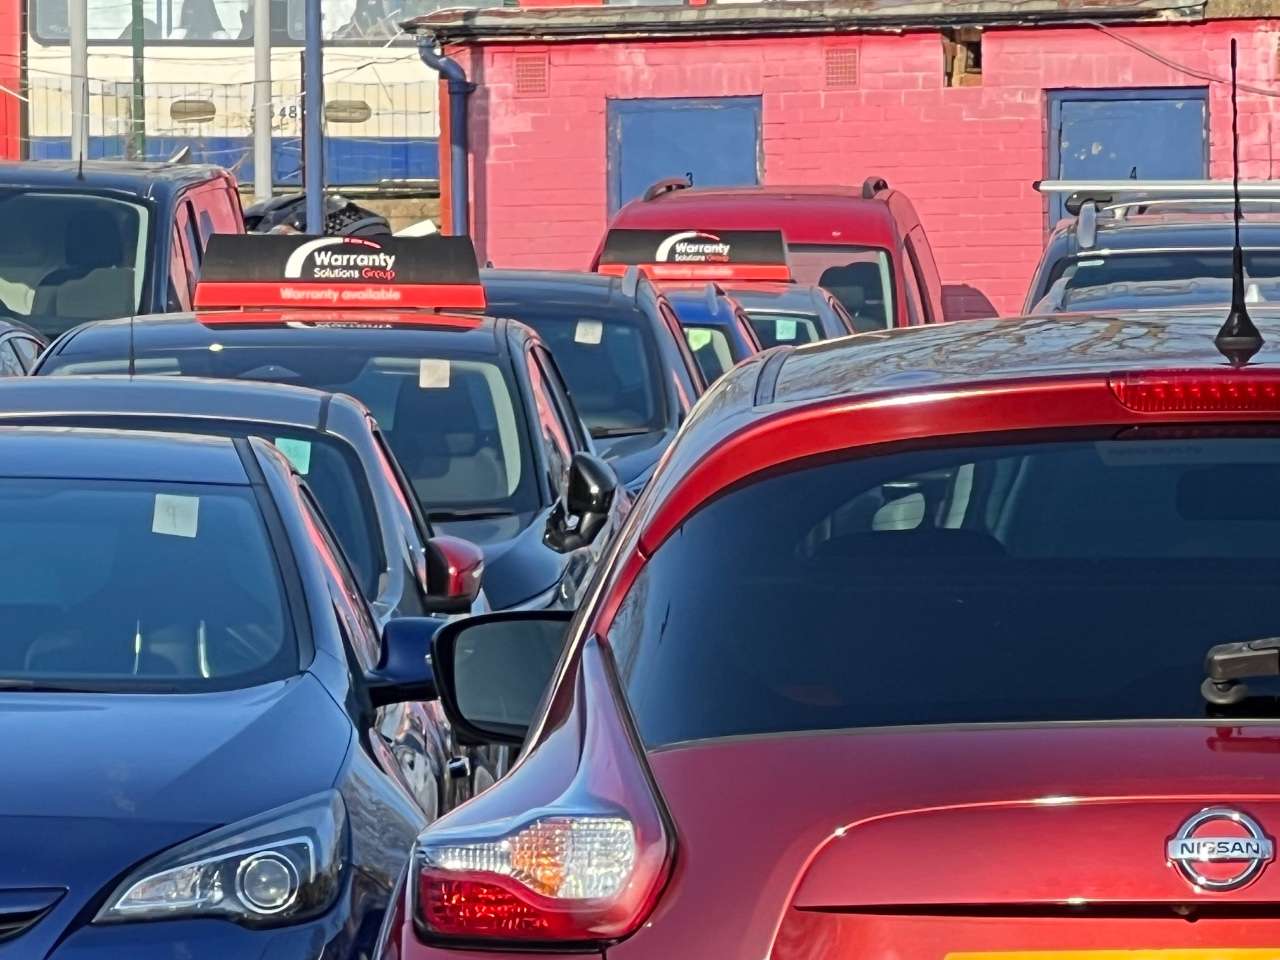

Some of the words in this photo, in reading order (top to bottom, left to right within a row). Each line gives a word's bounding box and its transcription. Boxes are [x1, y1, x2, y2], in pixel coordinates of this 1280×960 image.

[675, 242, 731, 256] Warranty
[313, 251, 396, 271] Warranty
[313, 268, 360, 279] Solutions
[361, 267, 396, 281] Group
[280, 287, 340, 304] Warranty
[340, 287, 402, 301] available
[1180, 841, 1261, 855] NISSAN
